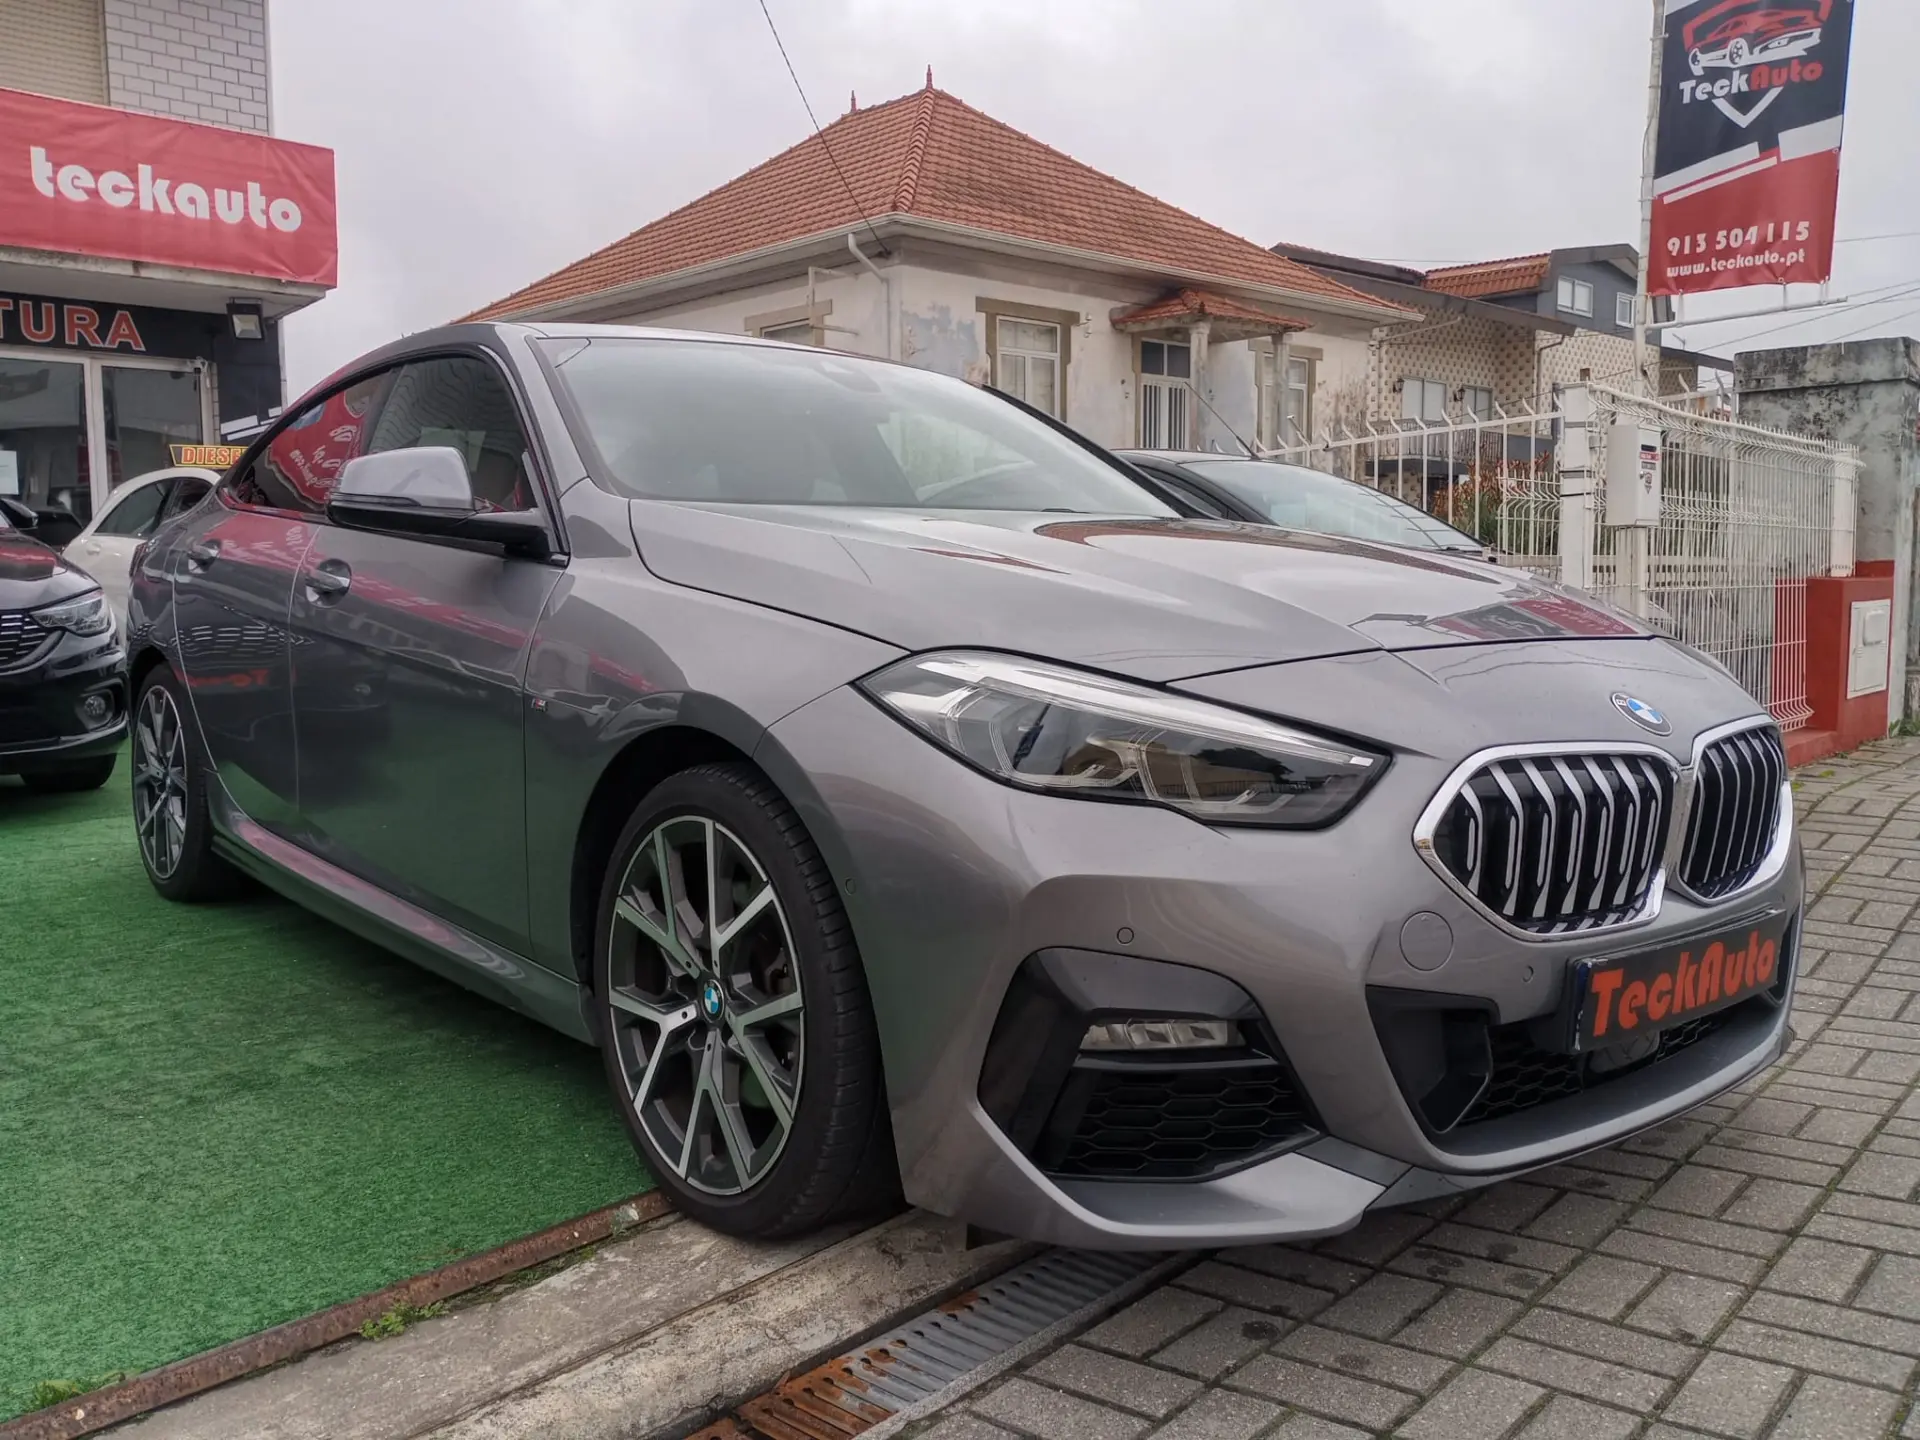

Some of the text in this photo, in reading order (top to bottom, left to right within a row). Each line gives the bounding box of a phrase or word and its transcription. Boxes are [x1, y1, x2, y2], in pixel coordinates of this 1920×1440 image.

[1679, 59, 1823, 104] TeckAuto
[29, 145, 302, 233] teckauto
[1666, 221, 1810, 257] 913 504 115
[1666, 248, 1806, 278] www.teckauto.pt
[1591, 929, 1776, 1037] TeckAuto
